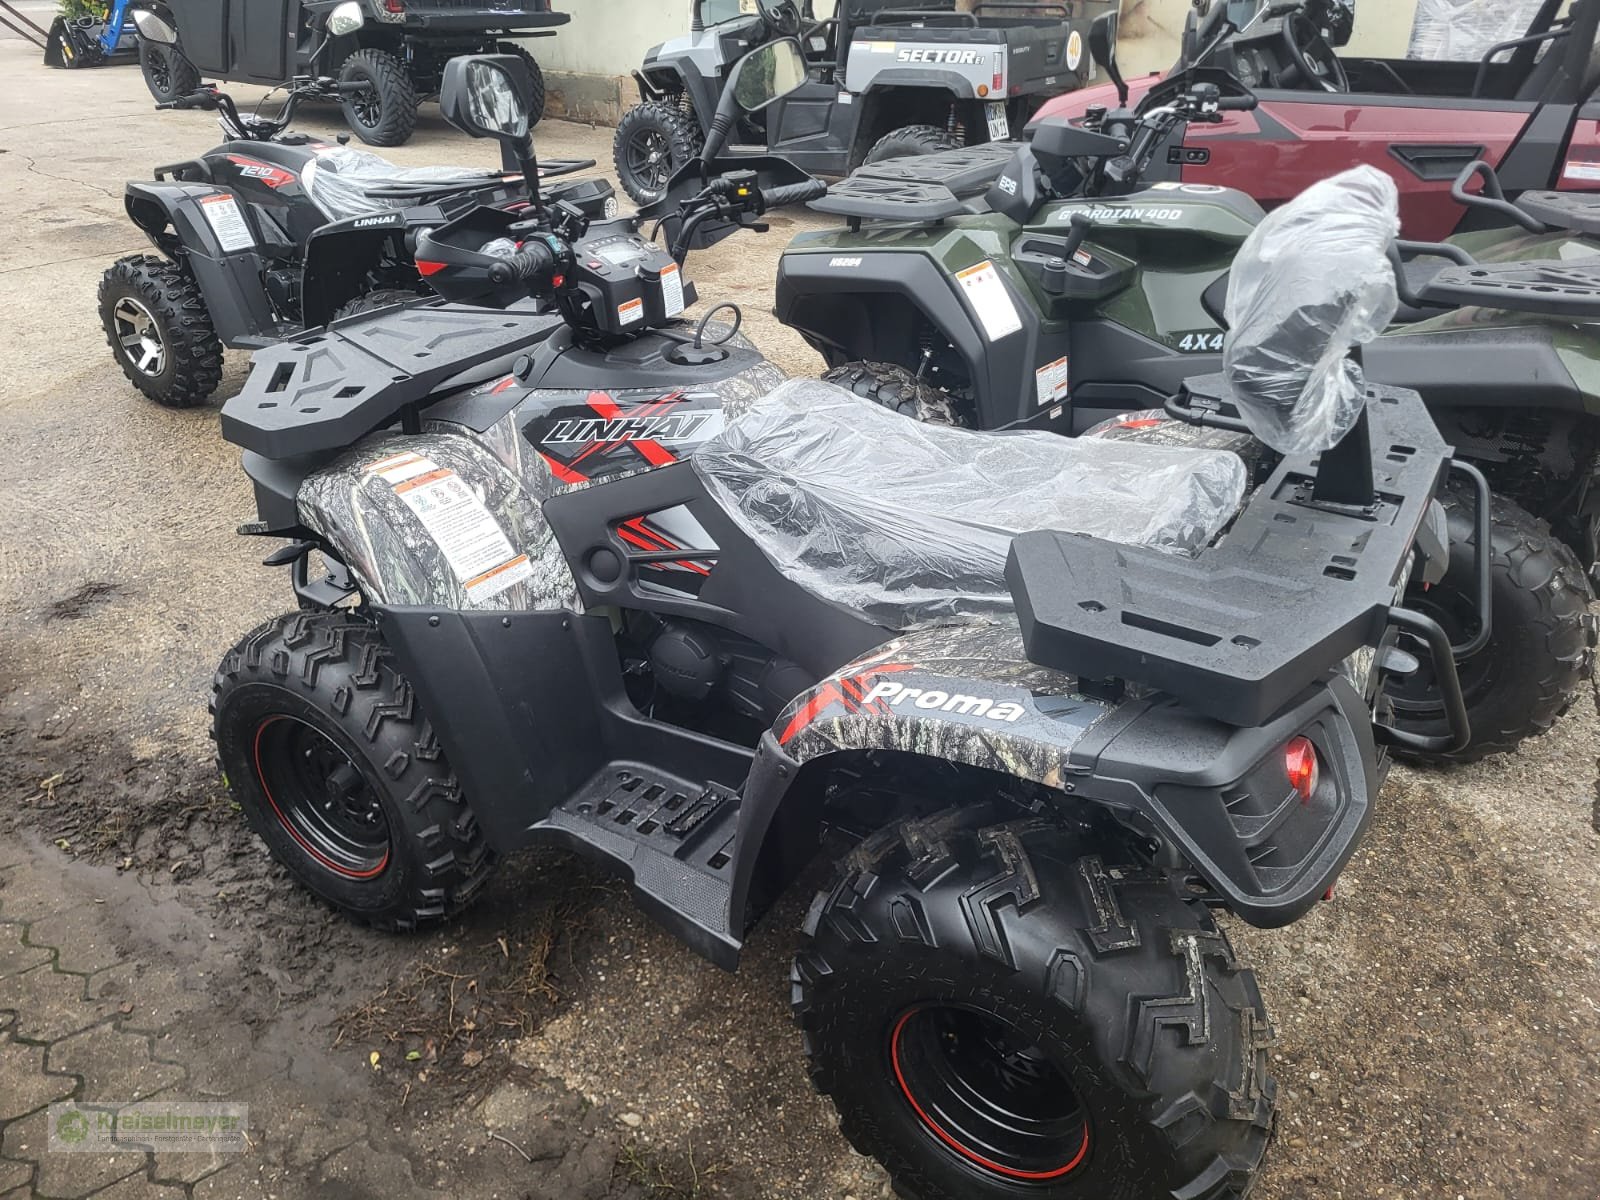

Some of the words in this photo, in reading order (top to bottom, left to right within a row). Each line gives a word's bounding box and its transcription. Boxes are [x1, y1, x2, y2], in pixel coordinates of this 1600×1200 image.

[1069, 35, 1080, 57] 40
[897, 49, 976, 64] SECTOR
[999, 175, 1017, 193] EPS
[354, 215, 396, 227] LINHAI
[1146, 209, 1183, 220] 400
[1179, 334, 1223, 350] 4X4
[541, 413, 715, 444] LINHAI
[861, 681, 1026, 722] Proma
